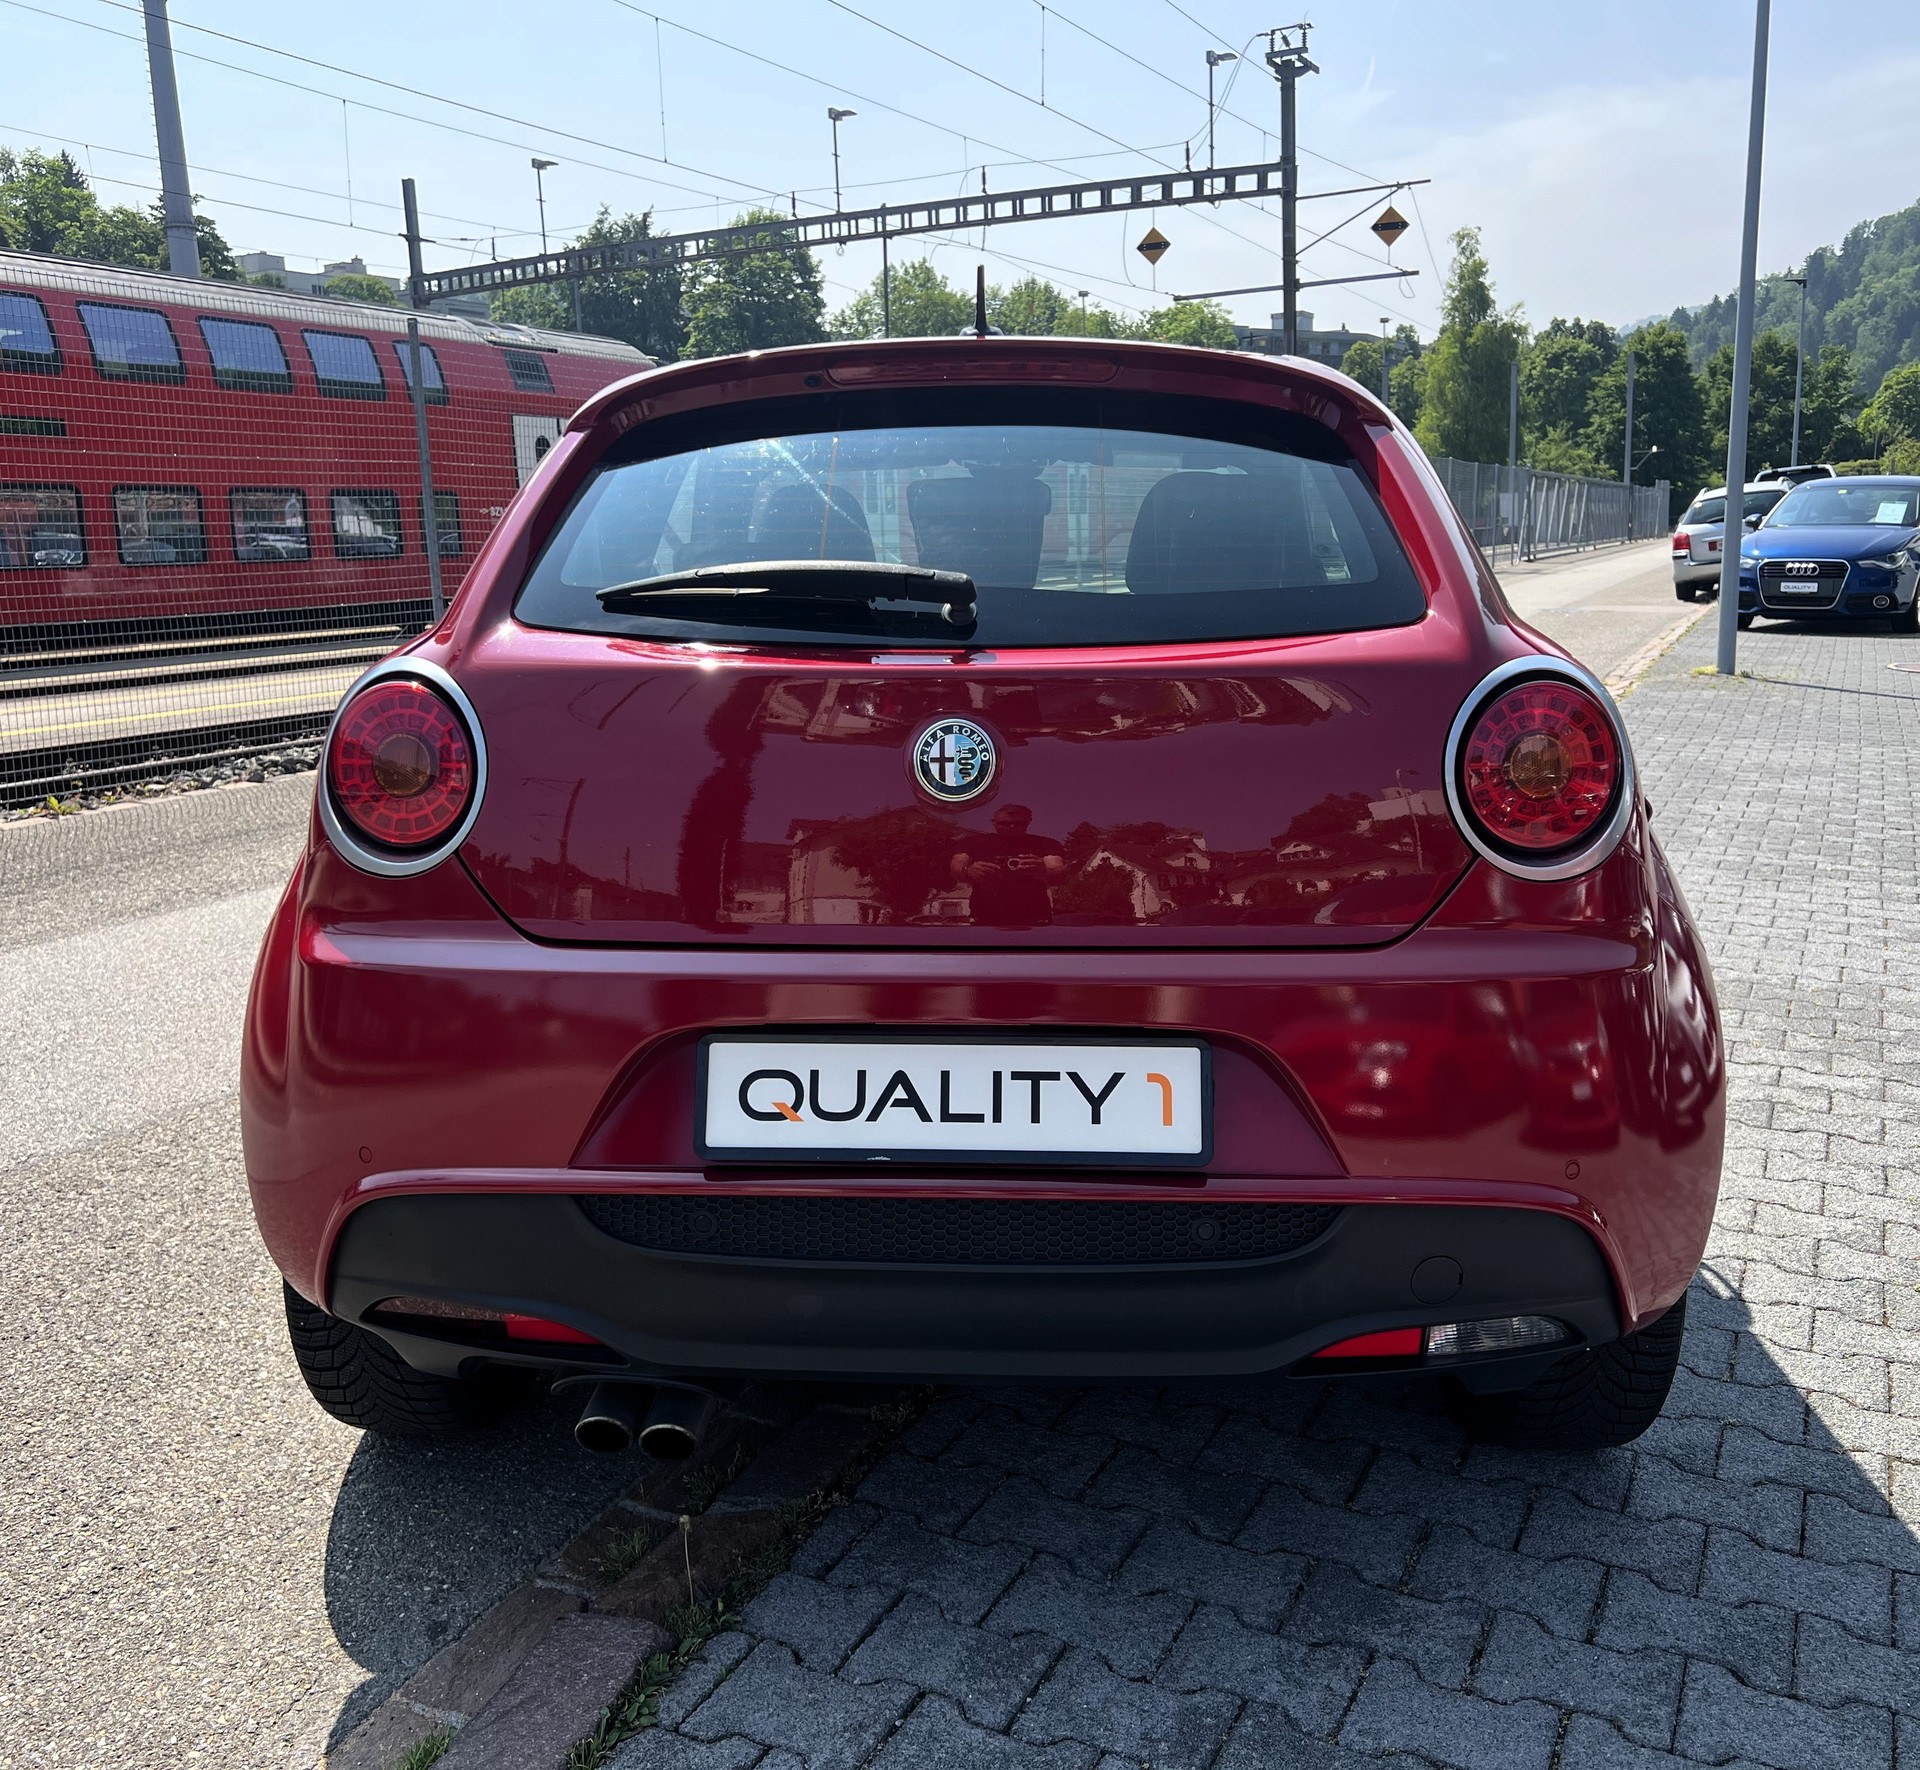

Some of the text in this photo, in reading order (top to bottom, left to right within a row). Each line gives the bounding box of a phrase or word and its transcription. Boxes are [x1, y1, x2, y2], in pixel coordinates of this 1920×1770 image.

[919, 725, 990, 763] ALFA ROMEO
[738, 1069, 1173, 1126] QUALITY 1
